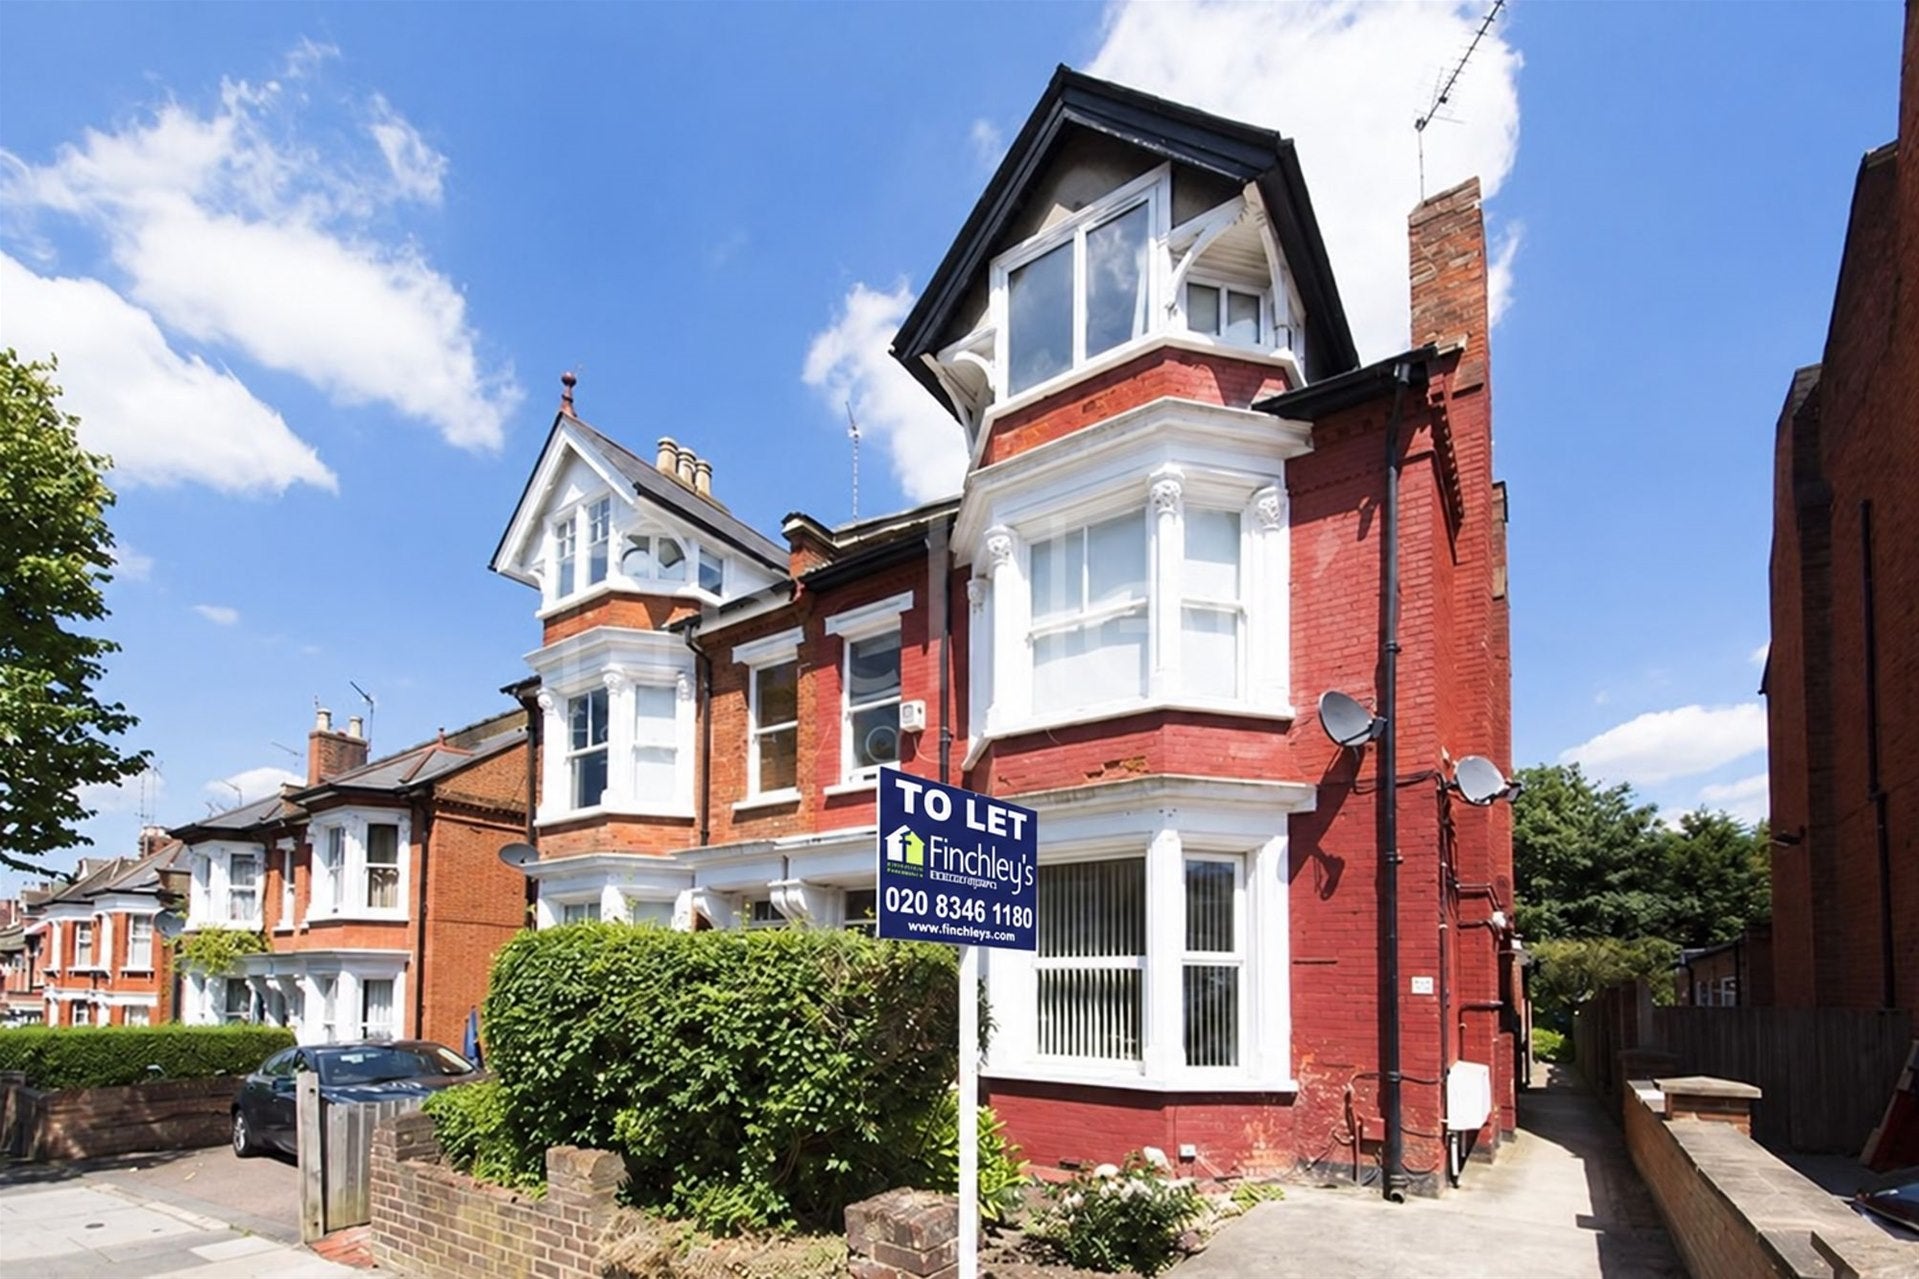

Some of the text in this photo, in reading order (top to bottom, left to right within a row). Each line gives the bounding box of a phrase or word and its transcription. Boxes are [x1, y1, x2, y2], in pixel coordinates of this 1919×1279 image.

[895, 778, 1027, 840] TO LET
[930, 835, 1033, 895] Finchley's
[885, 886, 1033, 929] 020 8346 1180
[908, 922, 1015, 941] www.finchleys.com
